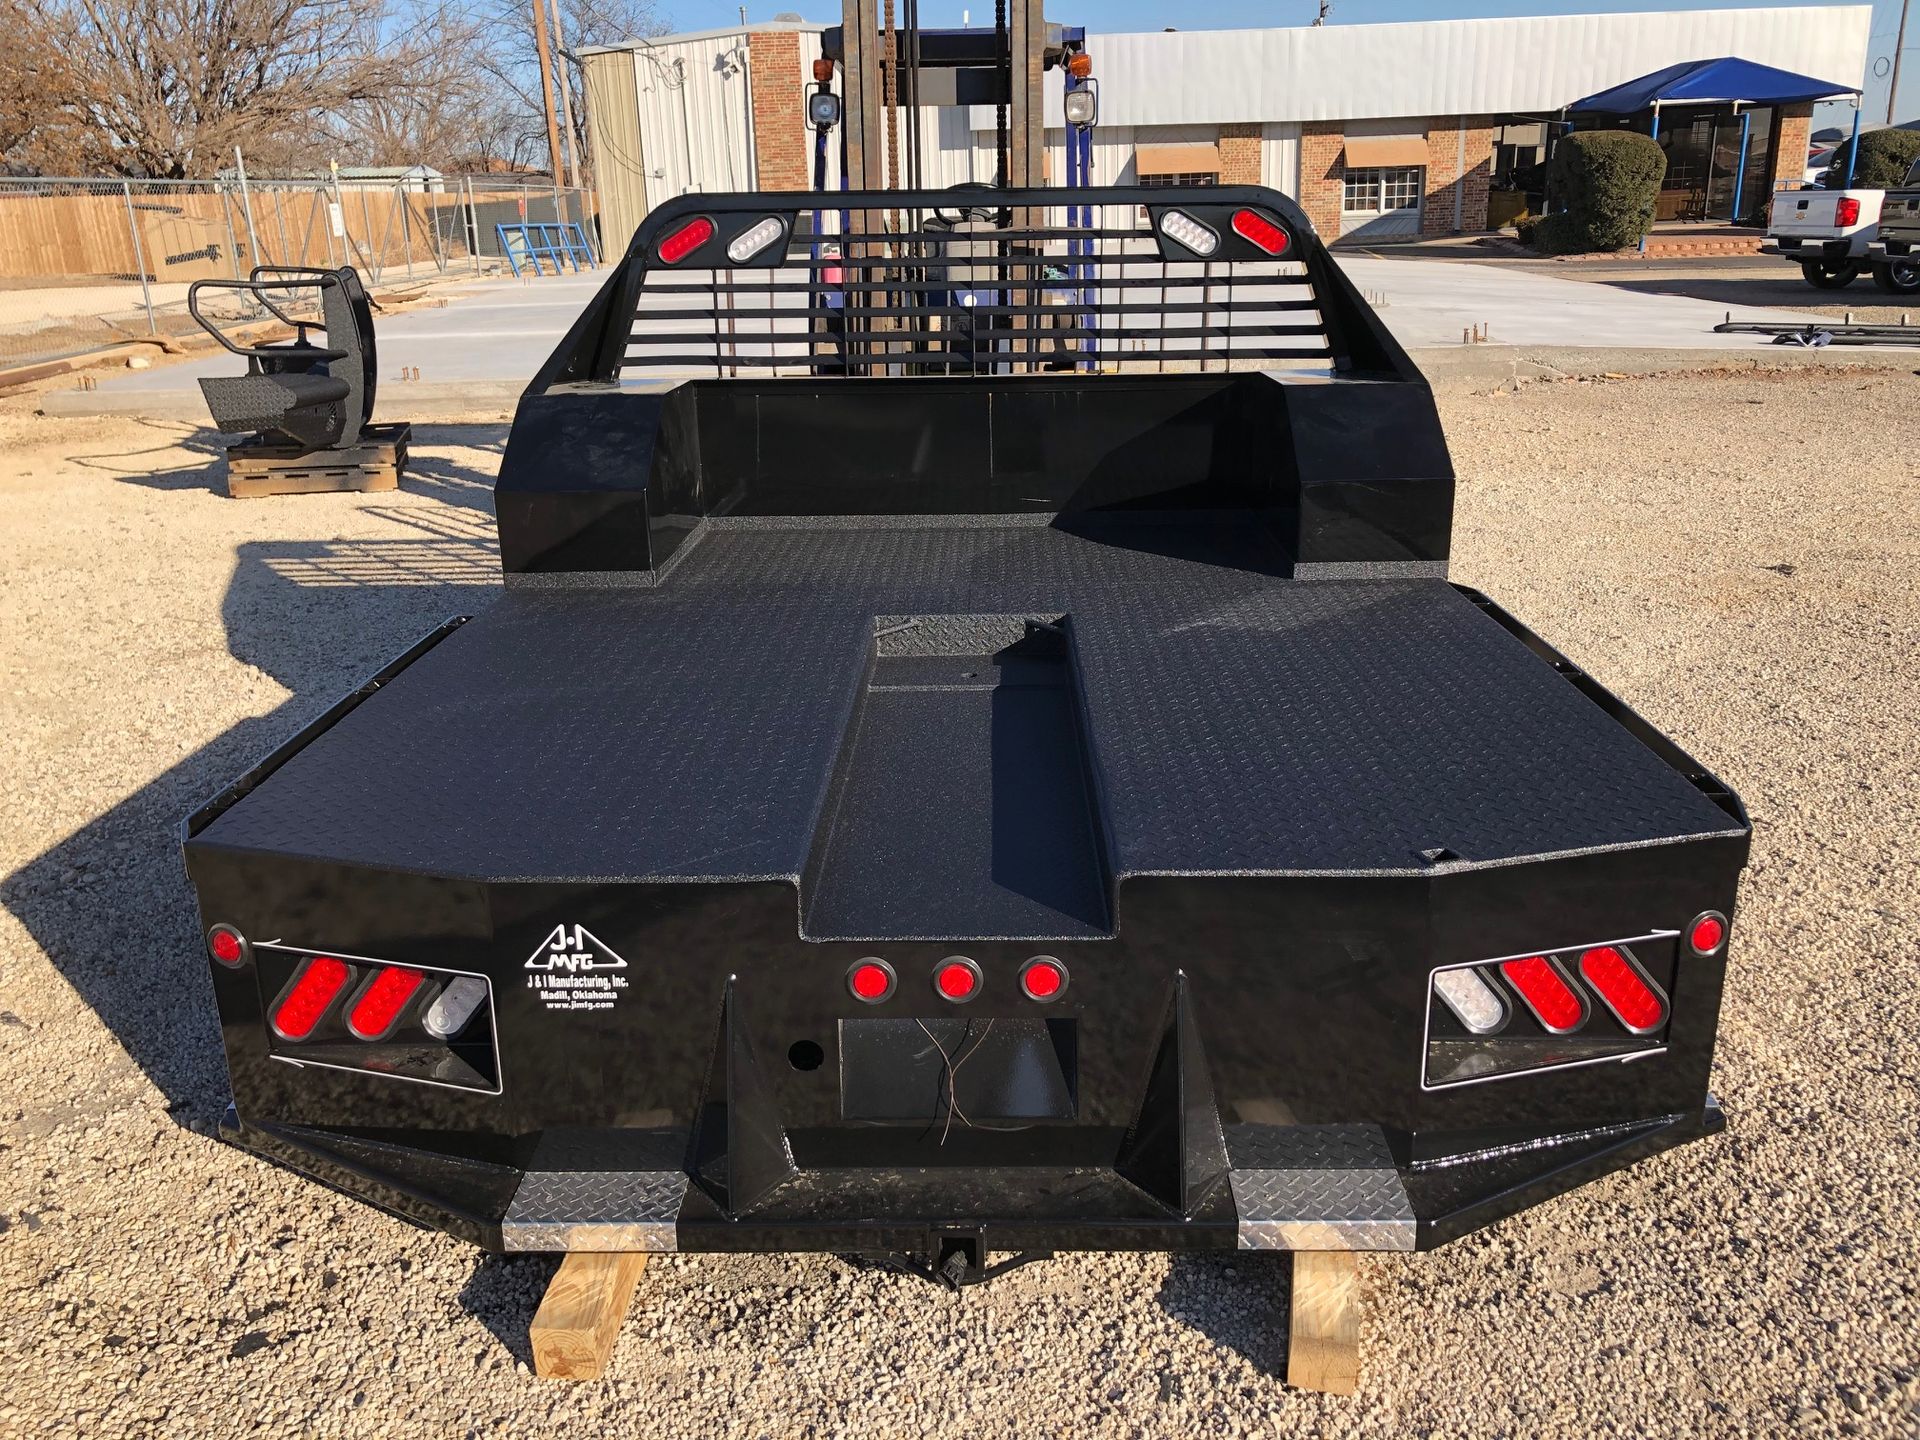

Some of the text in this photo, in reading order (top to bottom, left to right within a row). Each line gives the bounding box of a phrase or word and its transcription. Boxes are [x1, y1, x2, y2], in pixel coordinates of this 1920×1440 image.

[547, 954, 593, 972] MFG
[527, 974, 533, 988] J
[535, 974, 542, 988] &
[548, 974, 611, 990] Manufacturing,
[612, 974, 629, 988] Inc.
[540, 990, 617, 1001] Madill, Oklahoma
[546, 1001, 614, 1010] www.jimfg.com
